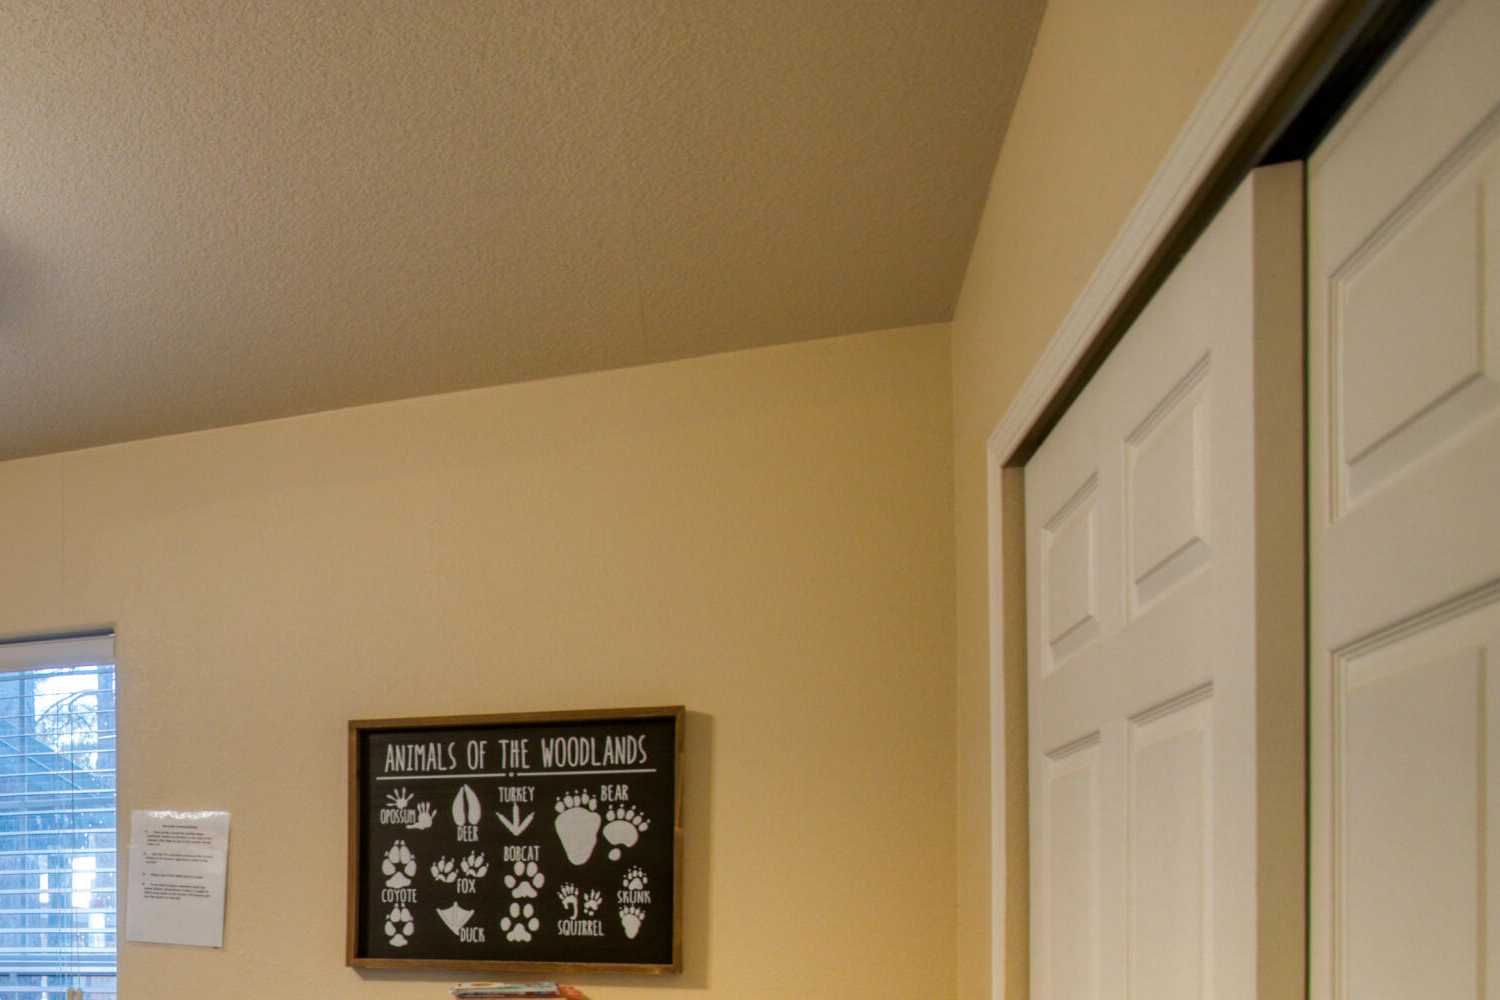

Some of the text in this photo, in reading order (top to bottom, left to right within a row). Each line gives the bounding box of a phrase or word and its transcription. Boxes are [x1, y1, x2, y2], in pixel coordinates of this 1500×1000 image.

[385, 735, 646, 772] ANIMALS OF THE WOODLANDS
[499, 787, 534, 803] TURKEY
[601, 785, 628, 801] BEAR
[380, 808, 416, 825] OPOSSUM
[458, 826, 478, 841] DEER
[504, 846, 539, 861] BOBCAT
[457, 879, 475, 893] FOX
[382, 888, 417, 903] COYOTE
[617, 889, 650, 903] SKUNK
[460, 926, 484, 942] DUCK
[558, 919, 604, 936] SQUIRREL
